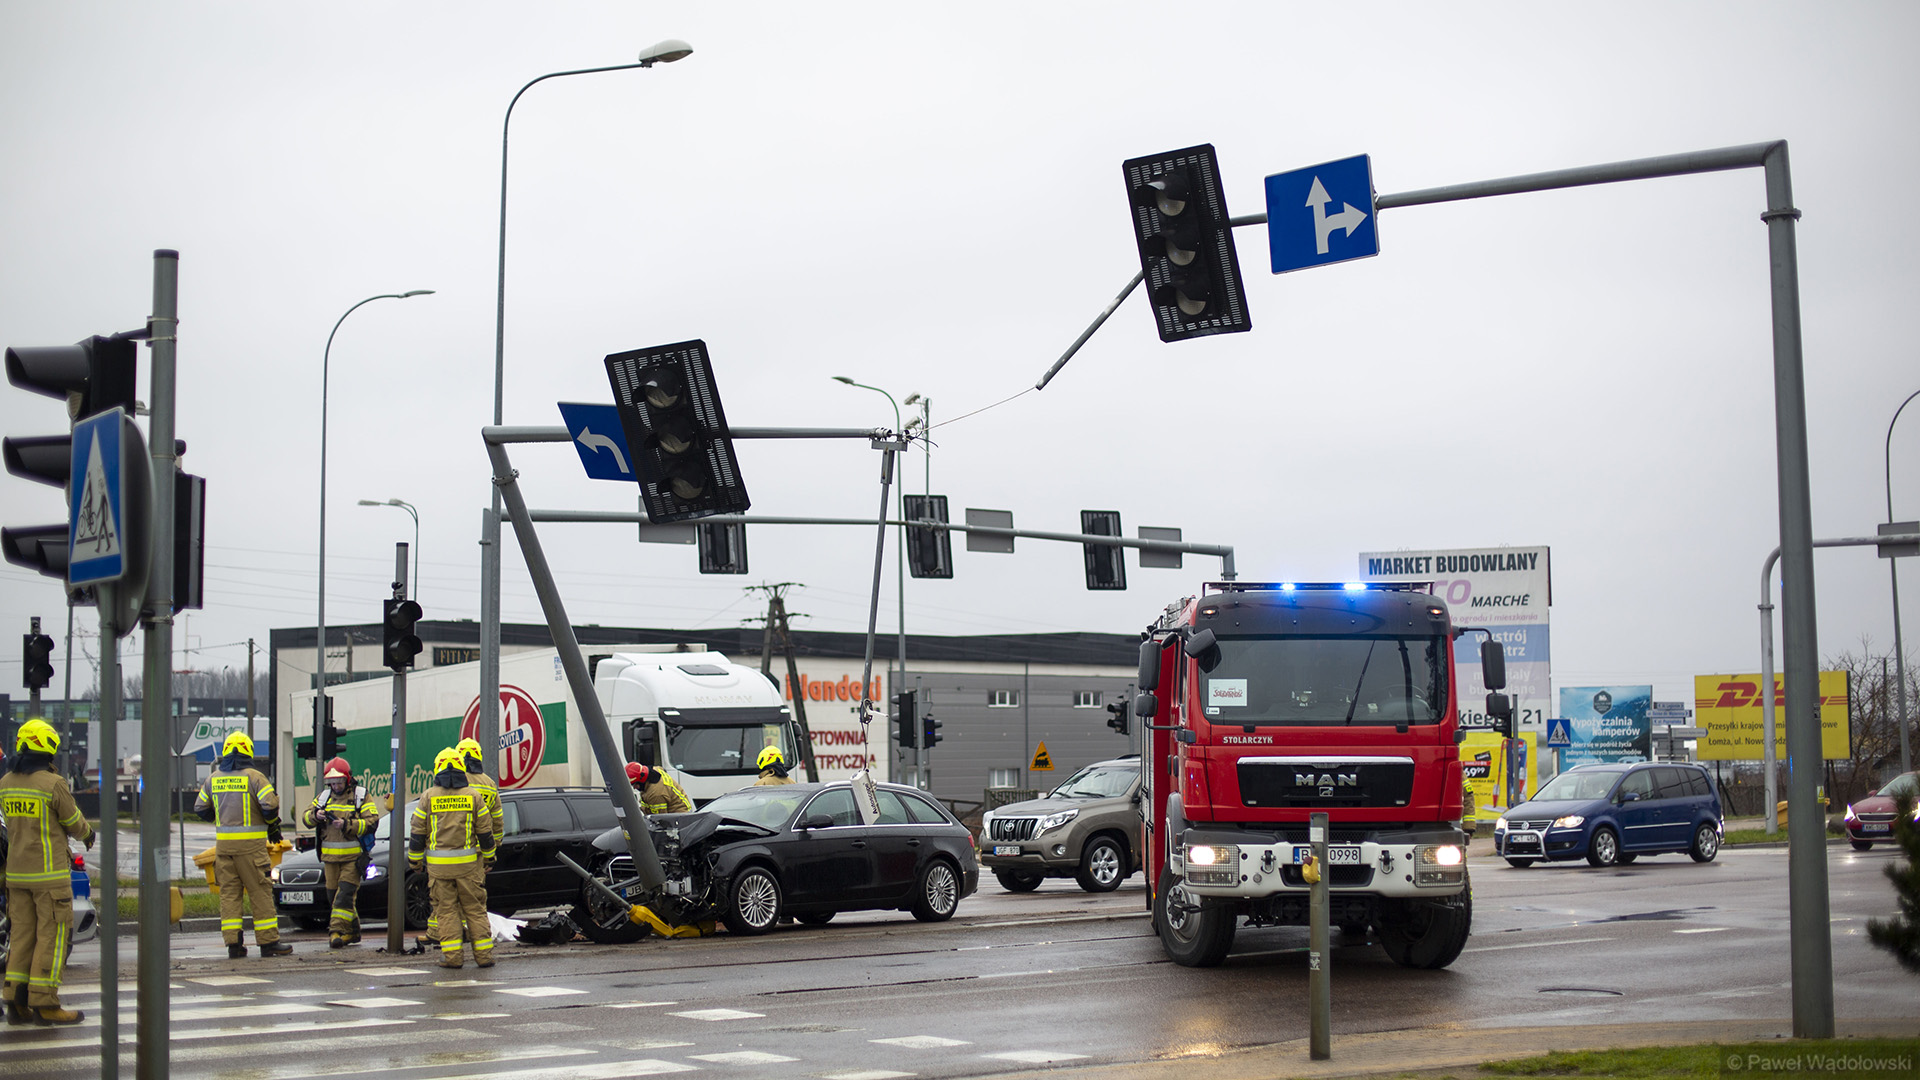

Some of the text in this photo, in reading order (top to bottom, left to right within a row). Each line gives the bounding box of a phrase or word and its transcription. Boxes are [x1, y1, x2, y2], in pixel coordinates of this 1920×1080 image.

[1368, 552, 1538, 576] MARKET BUDOWLANY
[1471, 593, 1530, 608] MARCHÉ
[1494, 613, 1538, 621] mieszkania
[1522, 709, 1542, 724] 21
[1570, 716, 1633, 728] Wypożyczalnia
[1592, 726, 1641, 738] kamperów
[1708, 721, 1739, 732] Przesyłki
[1741, 721, 1765, 732] krajow
[809, 730, 867, 746] RTOWNIA
[1223, 736, 1273, 744] STOLARCZYK
[1708, 737, 1733, 746] Łomża,
[1735, 737, 1743, 745] ul.
[800, 754, 878, 770] TRYCZNA
[1295, 773, 1357, 787] MAN
[1329, 849, 1359, 861] 0998
[627, 885, 642, 896] JB
